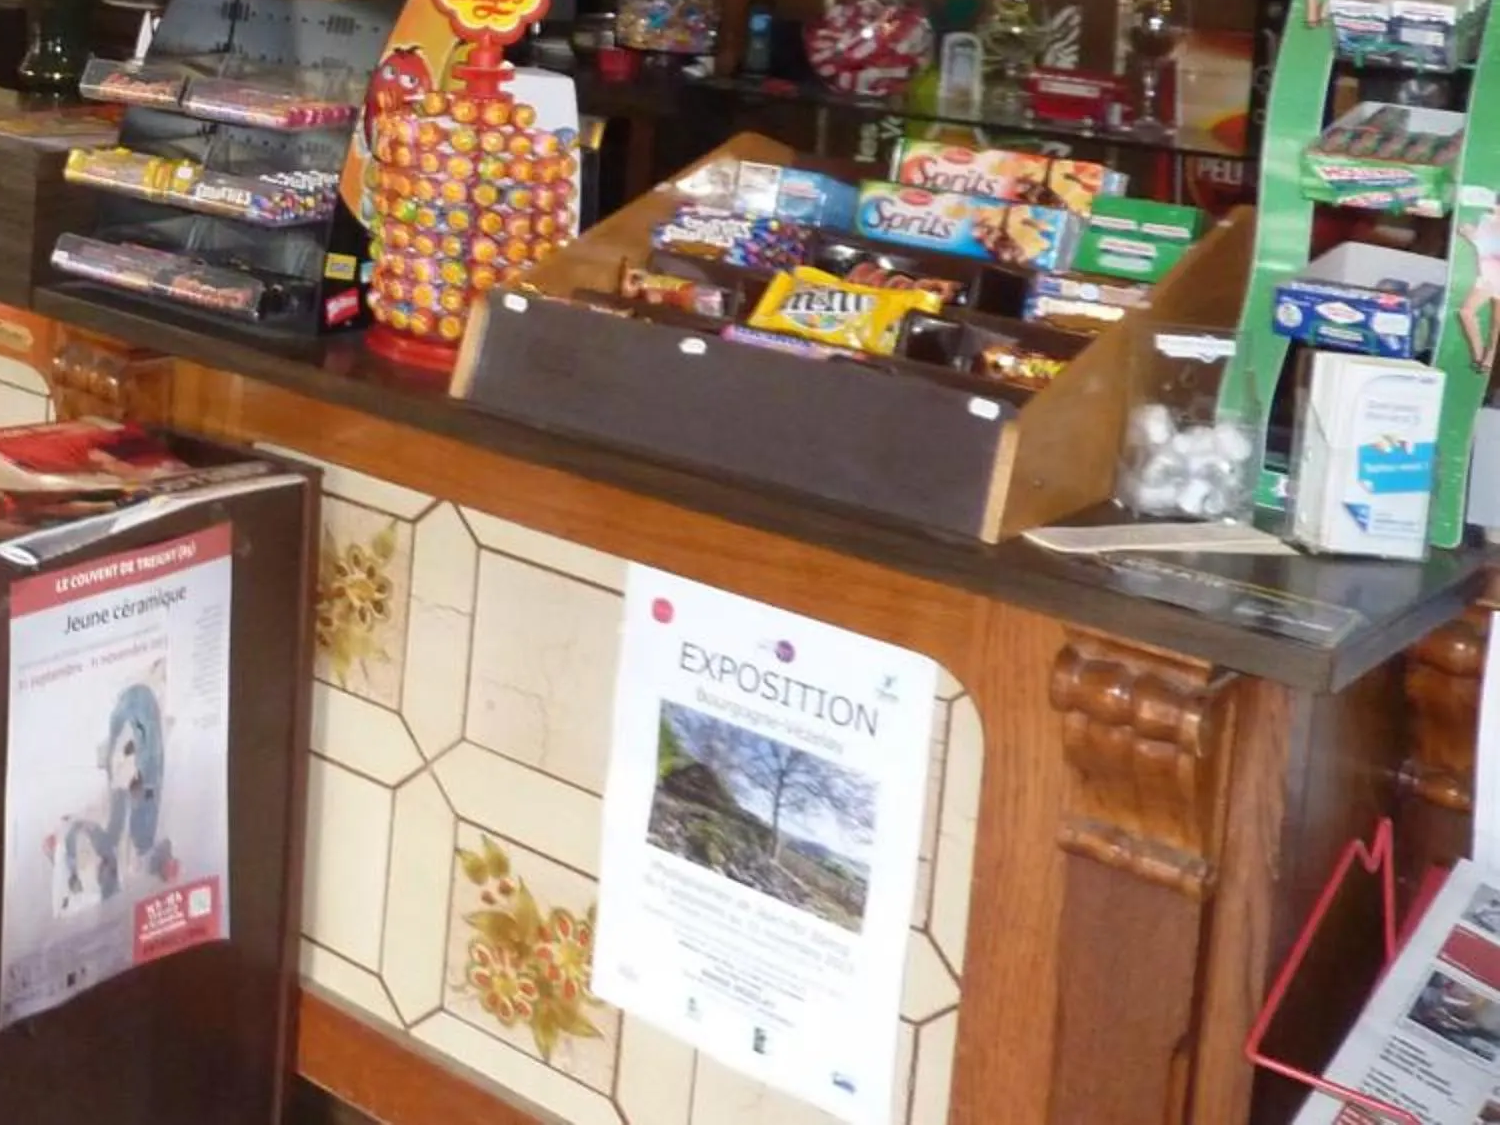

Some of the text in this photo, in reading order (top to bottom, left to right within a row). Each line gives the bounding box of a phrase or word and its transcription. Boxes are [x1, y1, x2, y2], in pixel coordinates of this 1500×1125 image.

[872, 200, 954, 238] Sprits
[55, 578, 69, 593] LE
[70, 563, 119, 590] COUVENT
[120, 559, 135, 576] DE
[64, 585, 188, 635] Jeune céramique
[678, 640, 880, 738] EXPOSITION
